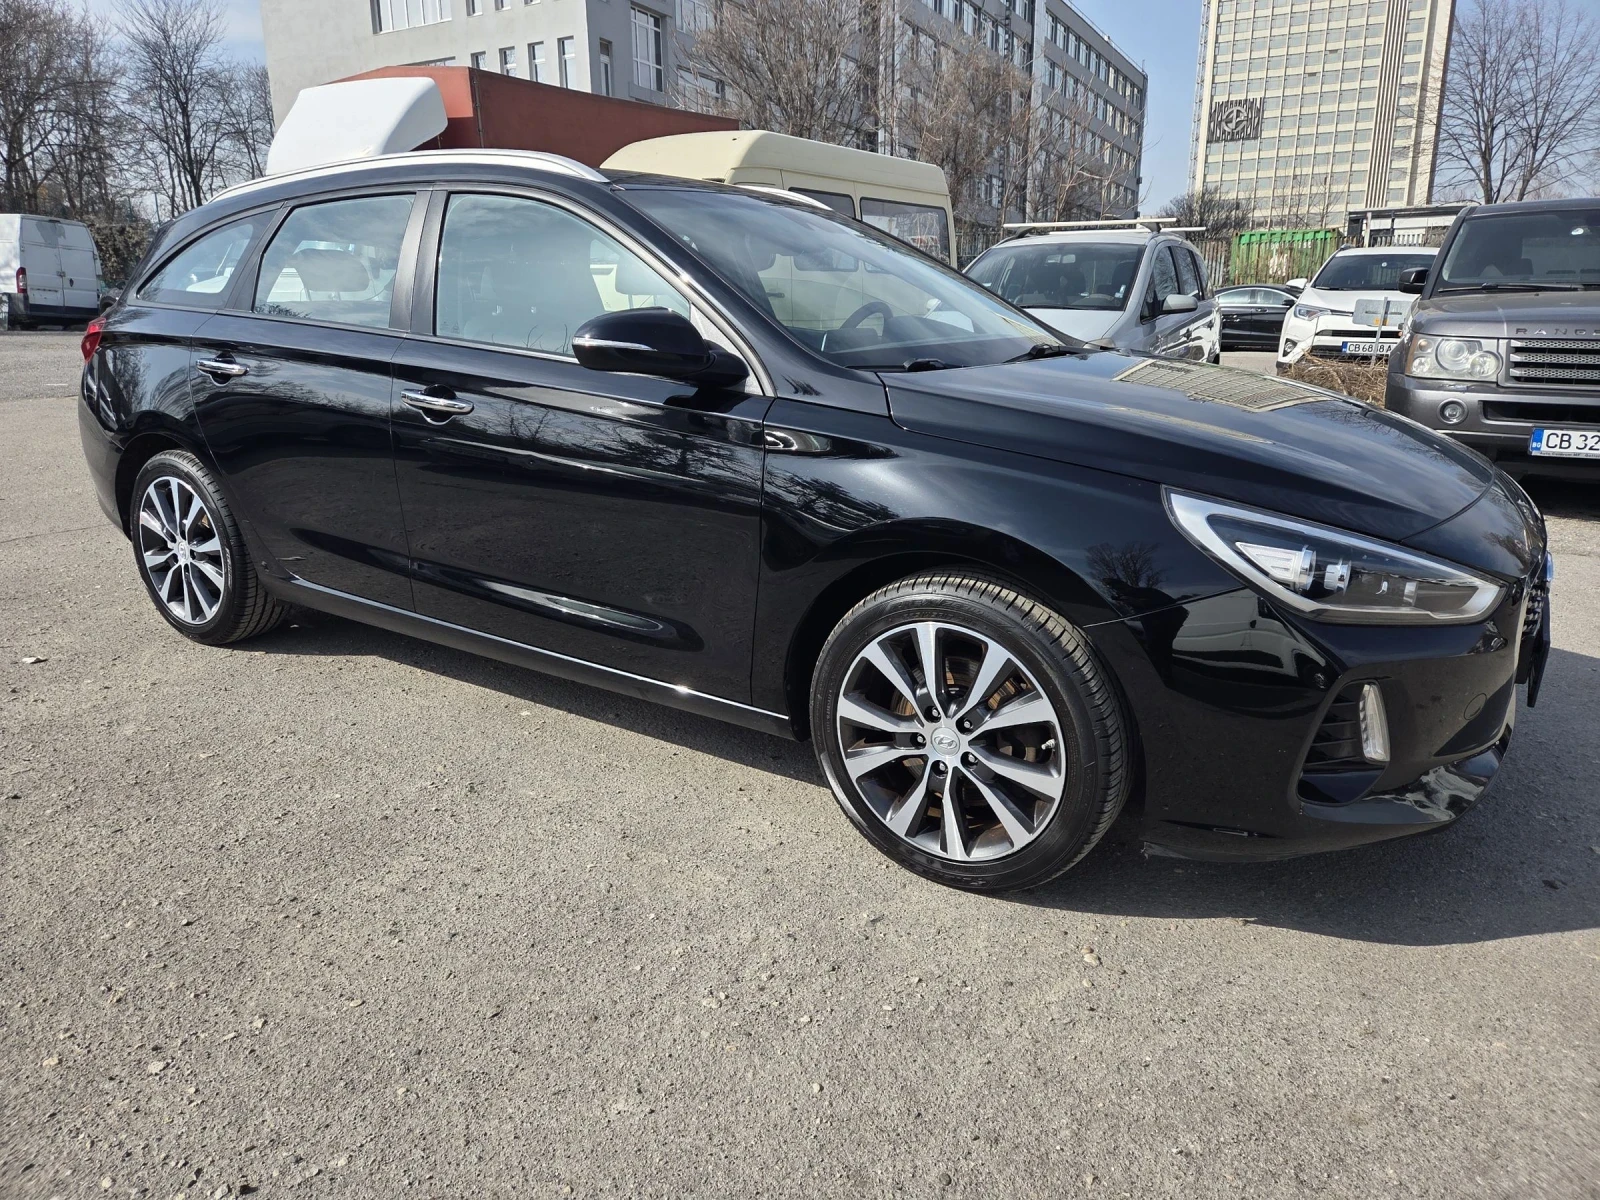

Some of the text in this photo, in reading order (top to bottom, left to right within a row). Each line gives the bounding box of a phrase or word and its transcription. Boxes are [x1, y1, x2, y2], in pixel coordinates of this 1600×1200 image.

[1348, 344, 1360, 352] CB
[1362, 344, 1385, 352] 688
[1545, 432, 1600, 451] CB 32
